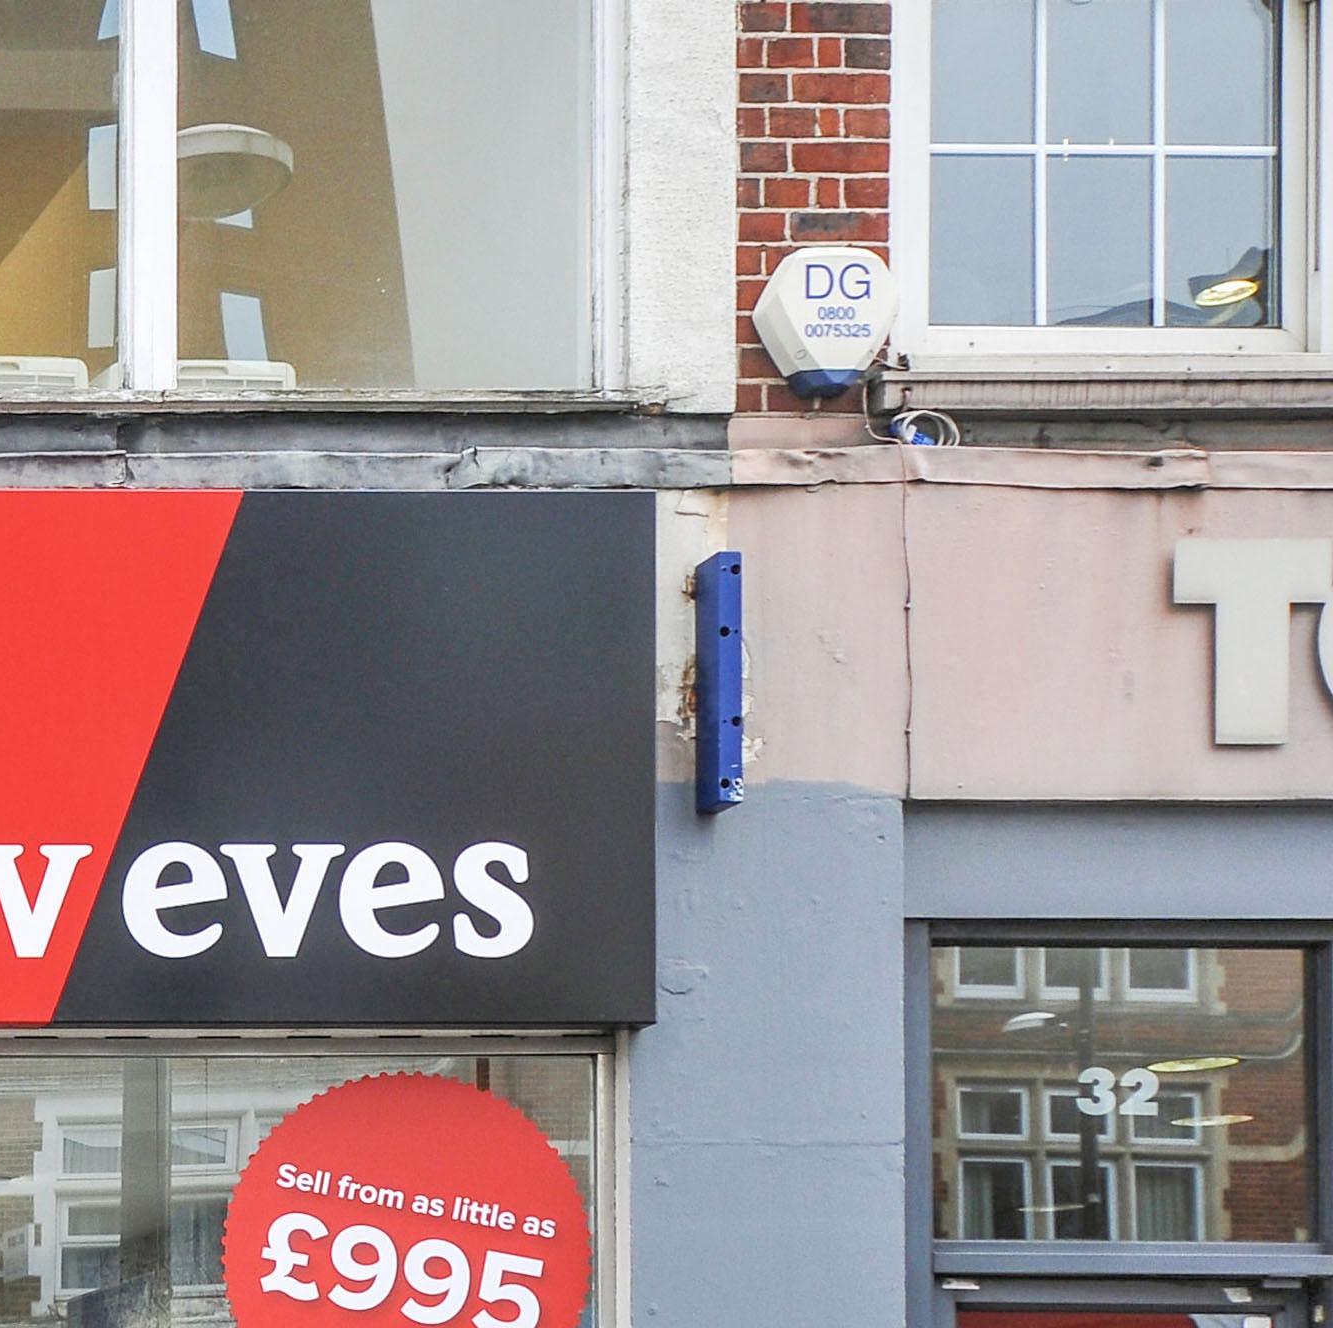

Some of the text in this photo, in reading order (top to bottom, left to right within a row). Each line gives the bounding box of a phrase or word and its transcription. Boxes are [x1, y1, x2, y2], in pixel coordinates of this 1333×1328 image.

[805, 263, 870, 300] DG
[805, 324, 871, 338] 0075325
[818, 306, 855, 320] 0800
[119, 841, 534, 960] eves
[1075, 1067, 1159, 1116] 32
[277, 1163, 557, 1239] Sell from as little as
